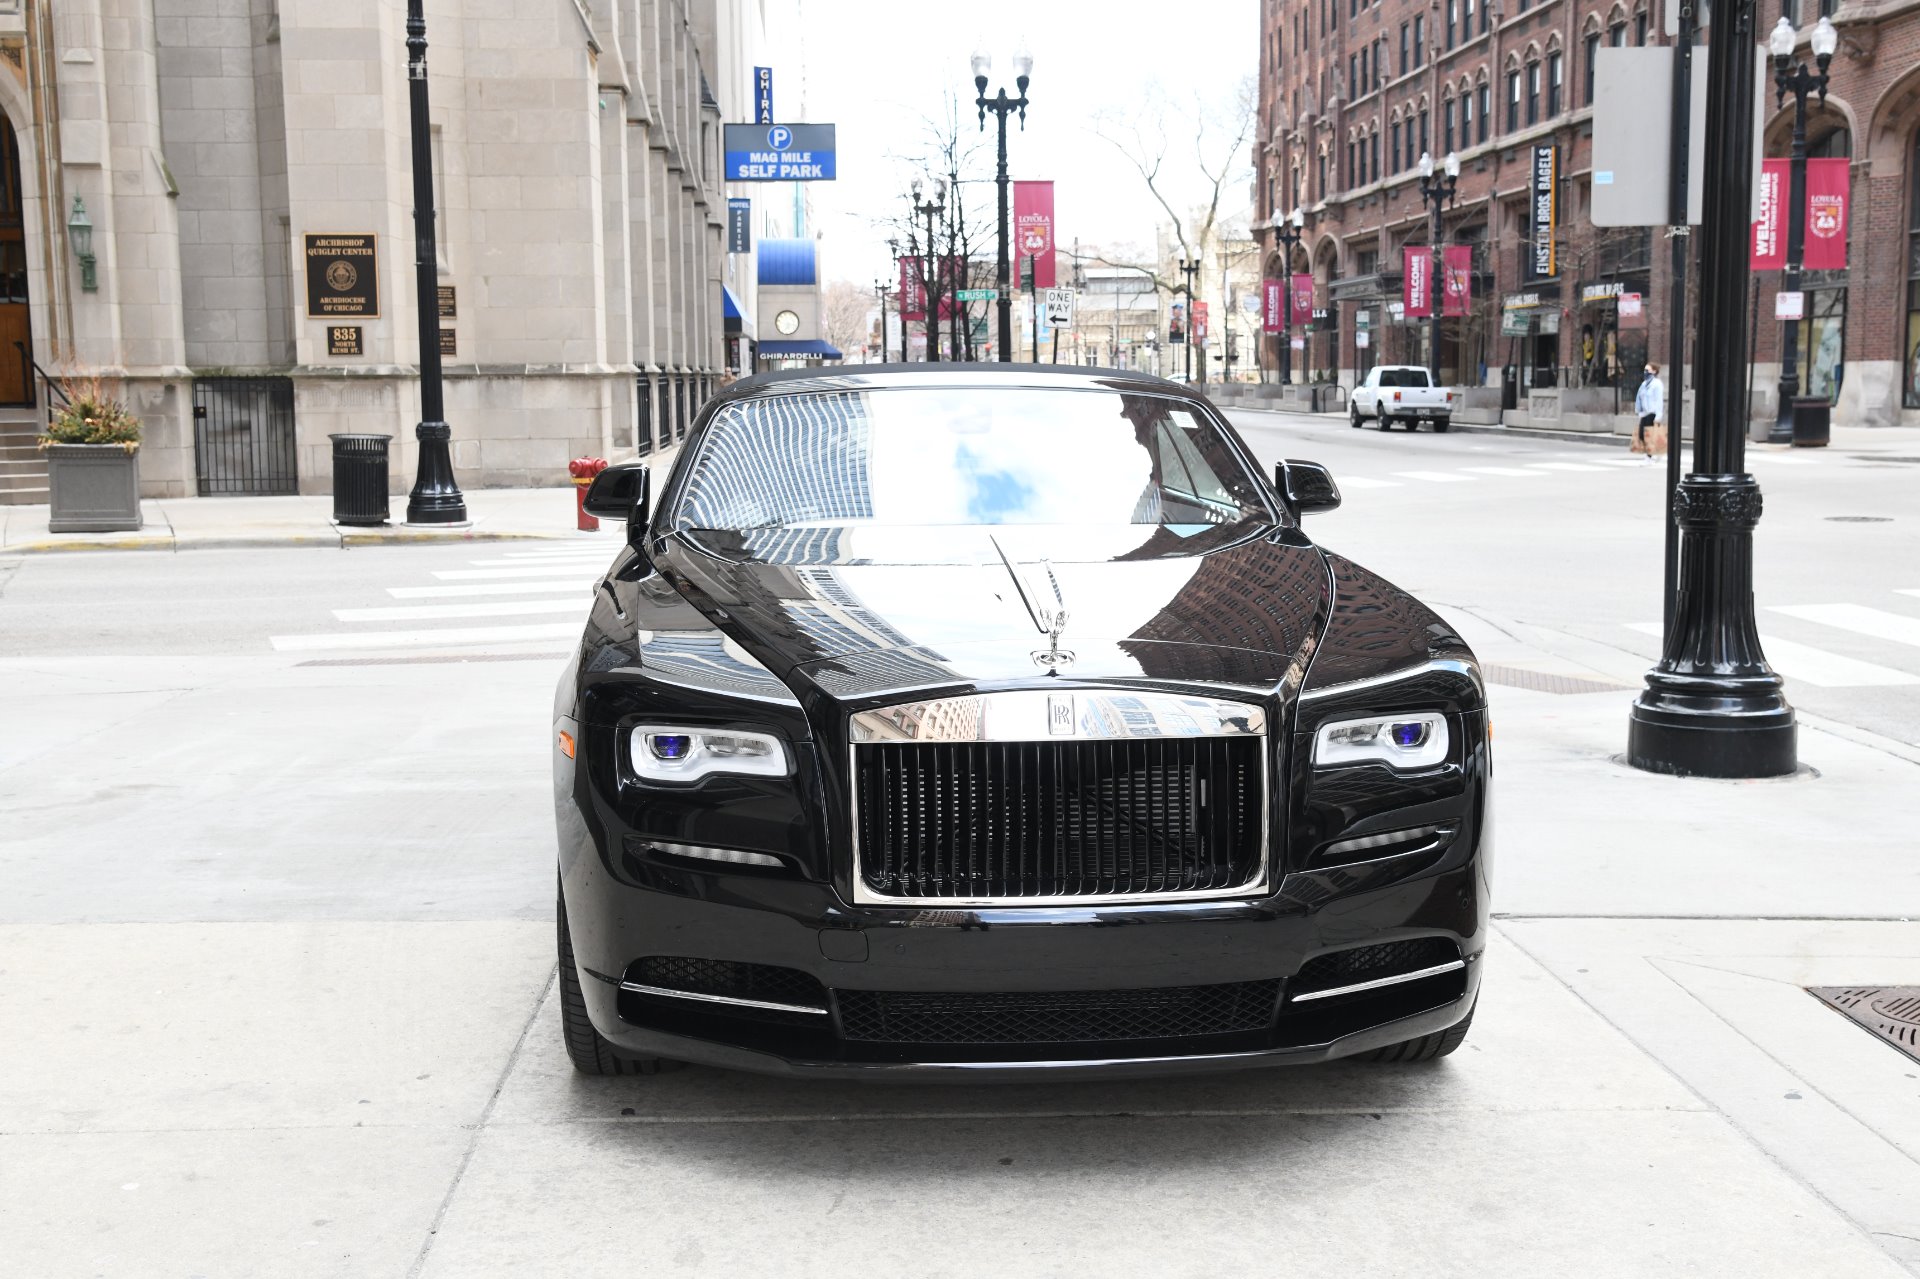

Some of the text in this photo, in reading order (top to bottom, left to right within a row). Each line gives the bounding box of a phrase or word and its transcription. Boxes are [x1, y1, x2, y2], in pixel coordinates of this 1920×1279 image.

[773, 129, 788, 147] P
[750, 152, 811, 163] MAG MILE
[738, 165, 822, 177] SELF PARK
[1536, 148, 1552, 274] EINSTEIN BROS. BAGELS
[1756, 172, 1771, 256] WELCOME
[1019, 215, 1050, 223] LOYOLA
[308, 248, 341, 256] QUIGLEY
[1411, 255, 1420, 308] WELCOME
[964, 292, 986, 300] RUSH
[1049, 292, 1070, 302] ONE
[1048, 303, 1070, 312] WAY
[333, 328, 356, 340] 835
[760, 352, 822, 360] GHIRARDELLI
